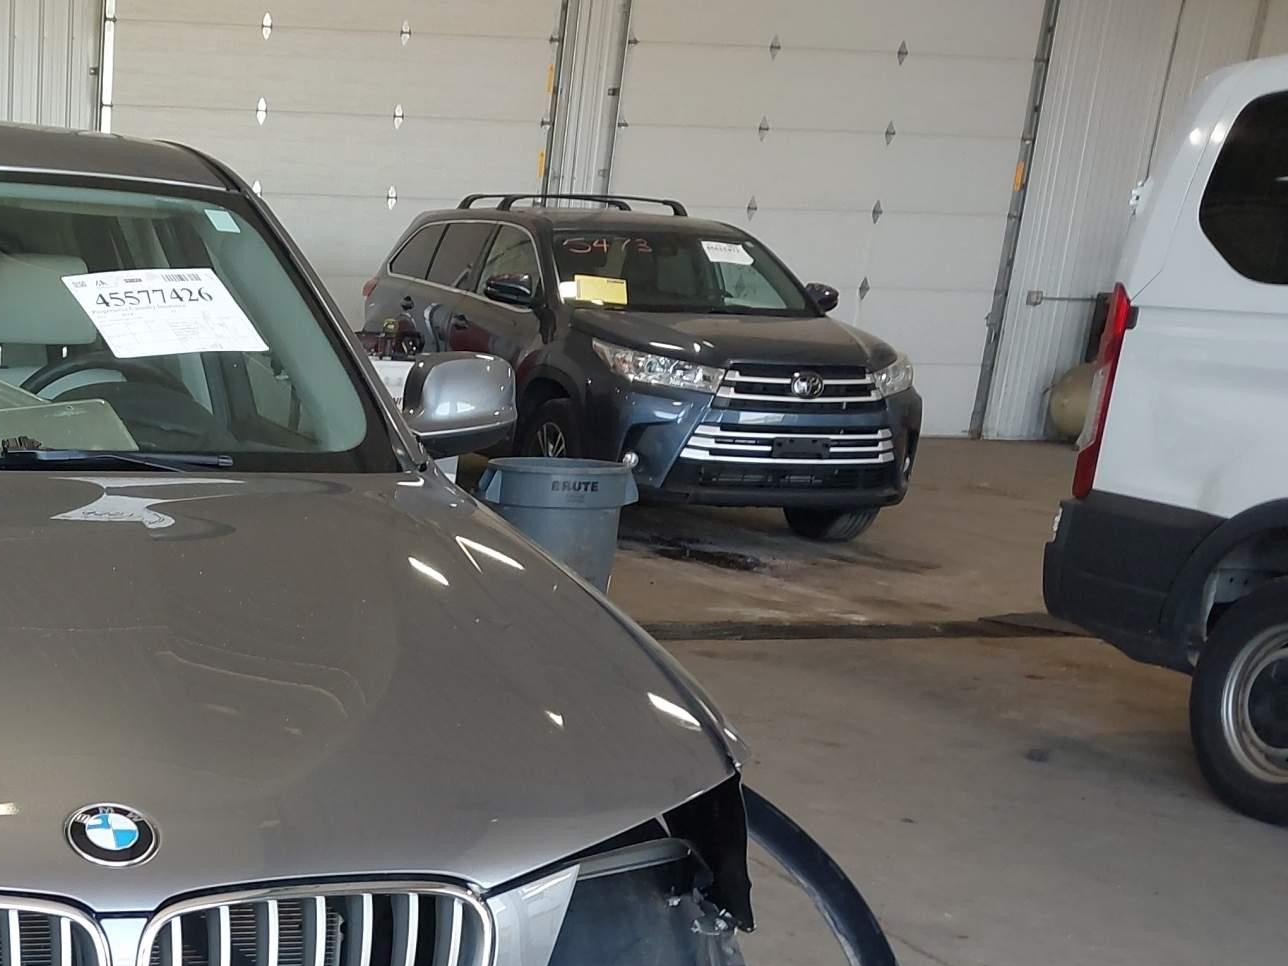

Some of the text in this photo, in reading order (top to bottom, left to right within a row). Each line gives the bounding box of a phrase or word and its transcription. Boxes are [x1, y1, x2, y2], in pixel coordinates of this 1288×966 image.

[562, 236, 652, 255] 5473
[94, 286, 213, 308] 45577426
[551, 480, 600, 493] BRUTE
